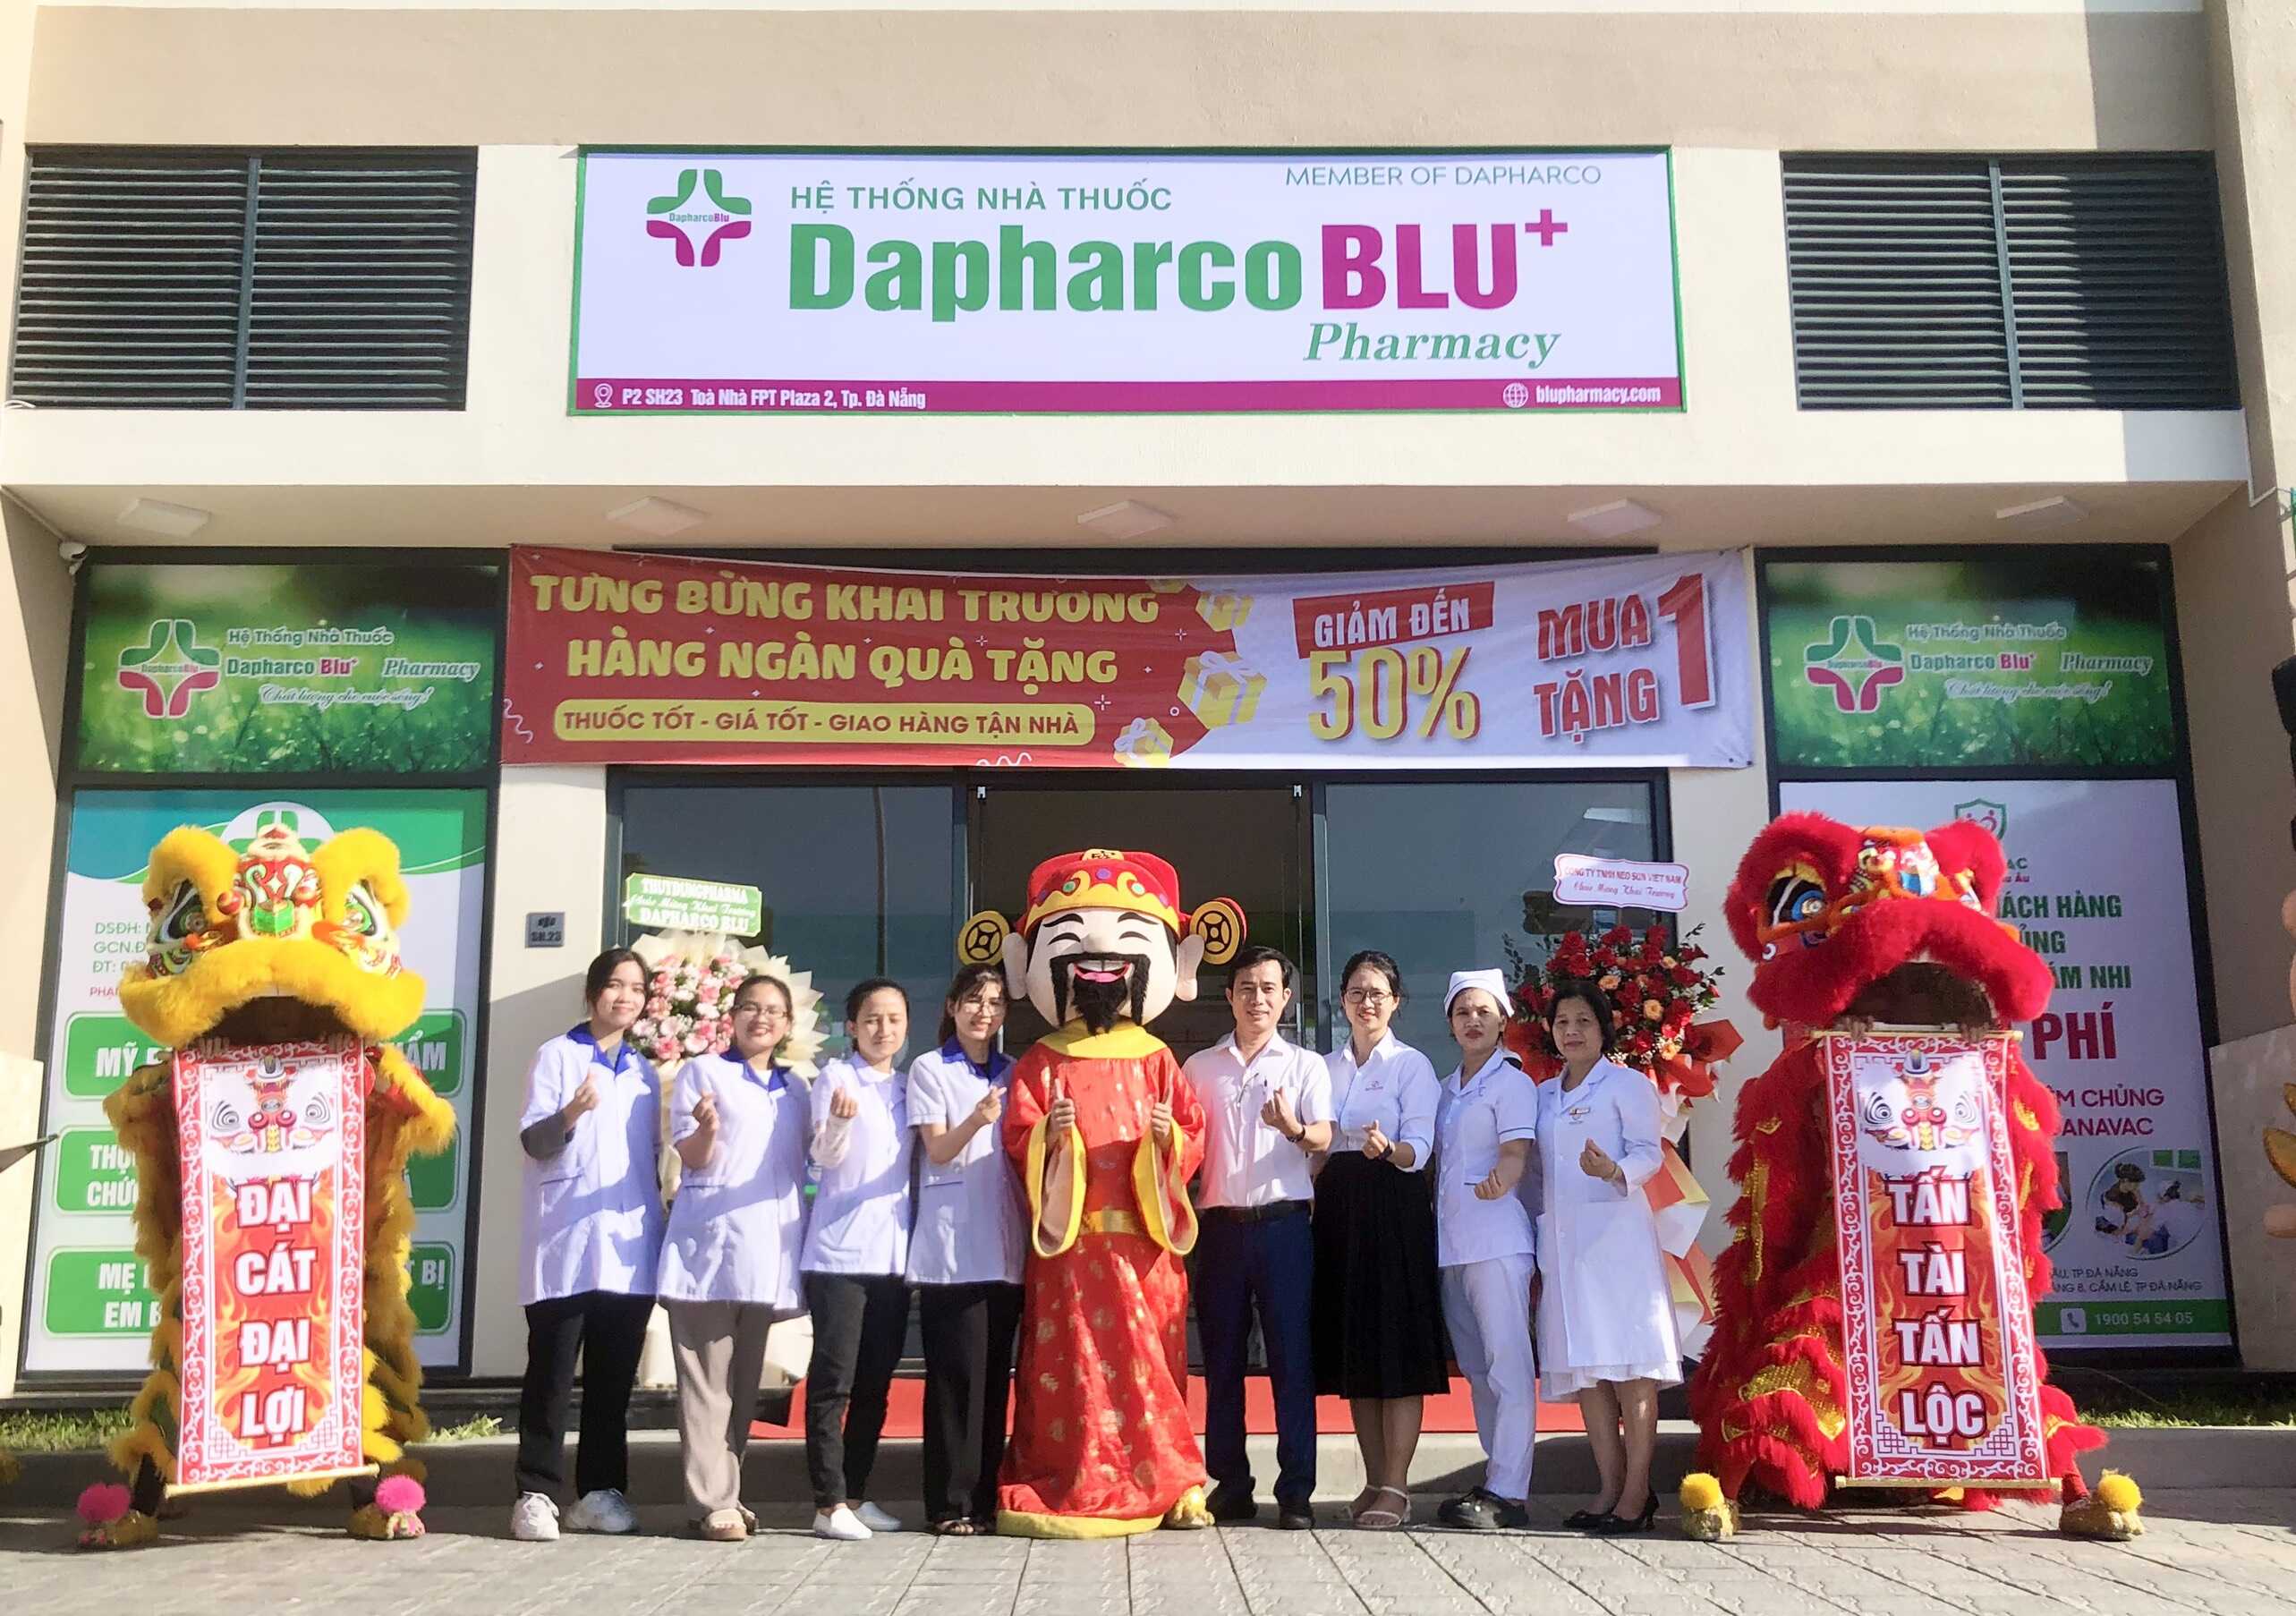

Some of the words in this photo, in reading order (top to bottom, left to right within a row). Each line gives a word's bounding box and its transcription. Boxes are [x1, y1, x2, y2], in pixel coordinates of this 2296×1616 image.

[1286, 166, 1402, 186] MEMBER
[1411, 166, 1447, 185] OF
[1456, 166, 1602, 186] DAPHARCO
[790, 180, 834, 214] HỆ
[846, 177, 965, 211] THỐNG
[978, 182, 1046, 211] NHÀ
[1058, 177, 1172, 211] THUỐC
[1303, 322, 1561, 369] Pharmacy
[622, 387, 642, 405] P2
[644, 387, 684, 406] SH23
[690, 387, 715, 405] Toà
[719, 387, 747, 406] Nhà
[751, 388, 778, 406] FPT
[780, 388, 820, 407] Plaza
[823, 389, 838, 409] 2,
[840, 388, 863, 409] Tp.
[865, 388, 885, 407] Đà
[889, 387, 926, 409] Nẵng
[1535, 385, 1662, 404] blupharmacy.com
[676, 570, 812, 620] BỪNG
[826, 583, 945, 622] KHAI
[1314, 600, 1398, 648] GIẢM
[1408, 588, 1470, 636] ĐẾN
[228, 630, 251, 646] Hệ
[255, 626, 303, 646] Thống
[308, 627, 340, 642] Nhà
[344, 626, 394, 643] Thuốc
[1537, 594, 1652, 661] MUA
[1658, 574, 1714, 710] 1
[227, 659, 314, 676] Dapharco
[384, 659, 480, 682] Pharmacy
[567, 625, 707, 677] HÀNG
[719, 631, 856, 681] NGÀN
[868, 636, 974, 689] QUÀ
[986, 636, 1118, 695] TẶNG
[1911, 653, 1995, 670] Dapharco
[2062, 653, 2153, 676] Pharmacy
[1307, 646, 1481, 741] 50%
[1534, 668, 1660, 744] TẶNG
[564, 705, 645, 731] THUỐC
[651, 705, 694, 730] TỐT
[716, 709, 759, 731] GIÁ
[766, 705, 809, 731] TỐT
[829, 713, 891, 732] GIAO
[899, 710, 970, 734] HÀNG
[976, 710, 1021, 739] TẬN
[1029, 710, 1079, 734] NHÀ
[2056, 889, 2122, 918] HÀNG
[94, 922, 141, 935] DSĐH:
[720, 916, 750, 931] BLU
[2020, 923, 2066, 954] ỦNG
[93, 940, 146, 954] GCN.Đ
[92, 960, 116, 974] ĐT:
[2089, 965, 2132, 989] NHI
[2031, 1001, 2116, 1060] PHÍ
[96, 1042, 139, 1077] MỸ
[2081, 1083, 2164, 1107] CHỦNG
[2060, 1117, 2154, 1136] ANAVAC
[237, 1181, 312, 1233] ĐẠI
[1886, 1166, 1970, 1226] TẤN
[98, 1263, 136, 1295] MẸ
[235, 1240, 317, 1295] CÁT
[421, 1259, 446, 1289] BỊ
[1898, 1241, 1967, 1296] TÀI
[104, 1301, 142, 1329] EM
[2095, 1313, 2129, 1325] 1900
[240, 1318, 310, 1374] ĐẠI
[1893, 1306, 1985, 1366] TẤN
[240, 1384, 308, 1447] LỢI
[1900, 1382, 1986, 1447] LỘC
